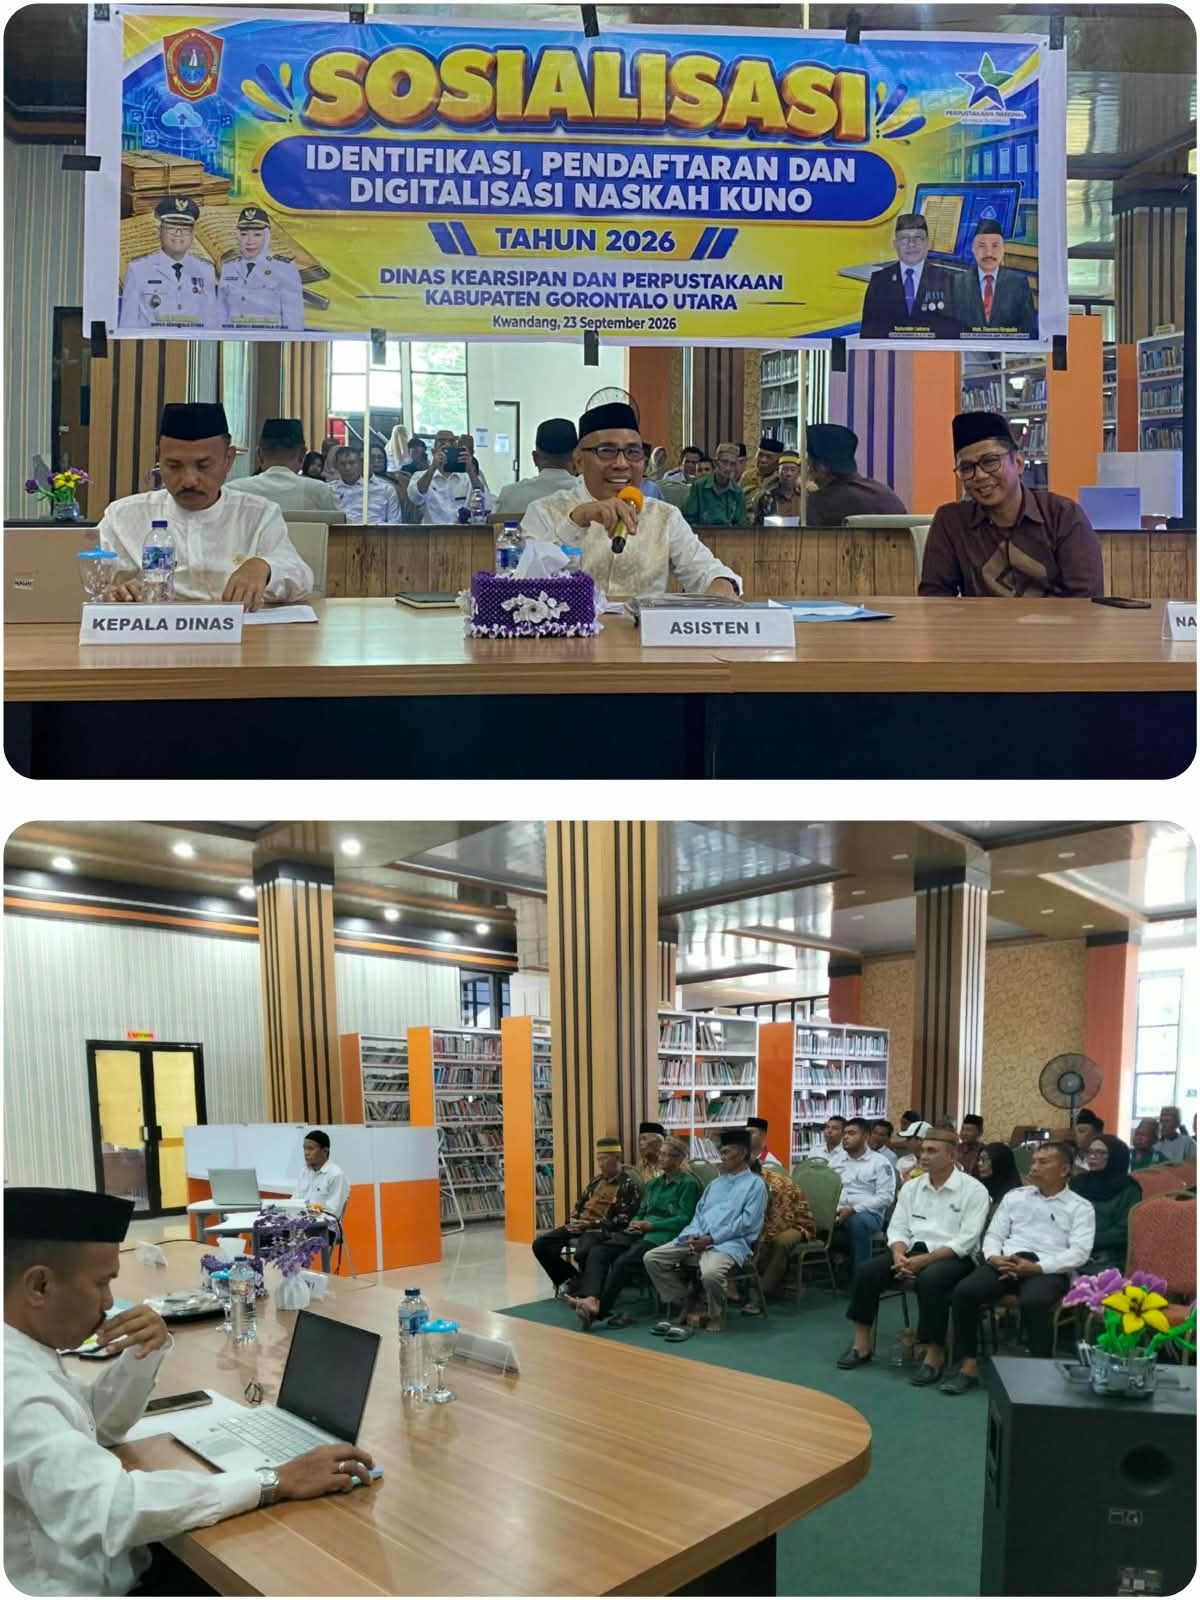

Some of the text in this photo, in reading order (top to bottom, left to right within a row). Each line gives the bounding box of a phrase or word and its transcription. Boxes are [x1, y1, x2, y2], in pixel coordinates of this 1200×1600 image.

[303, 47, 869, 142] SOSIALISASI
[306, 144, 856, 183] IDENTIFIKASI, PENDAFTARAN DAN
[350, 177, 813, 213] DIGITALISASI NASKAH KUNO
[495, 227, 676, 252] TAHUN 2026
[380, 268, 783, 290] DINAS KEARSIPAN DAN PERPUSTAKAAN
[425, 290, 738, 310] KABUPATEN GORONTALO UTARA
[492, 315, 677, 331] Kwandang, 23 September 2026
[92, 616, 235, 632] KEPALA DINAS
[669, 620, 761, 635] ASISTEN I
